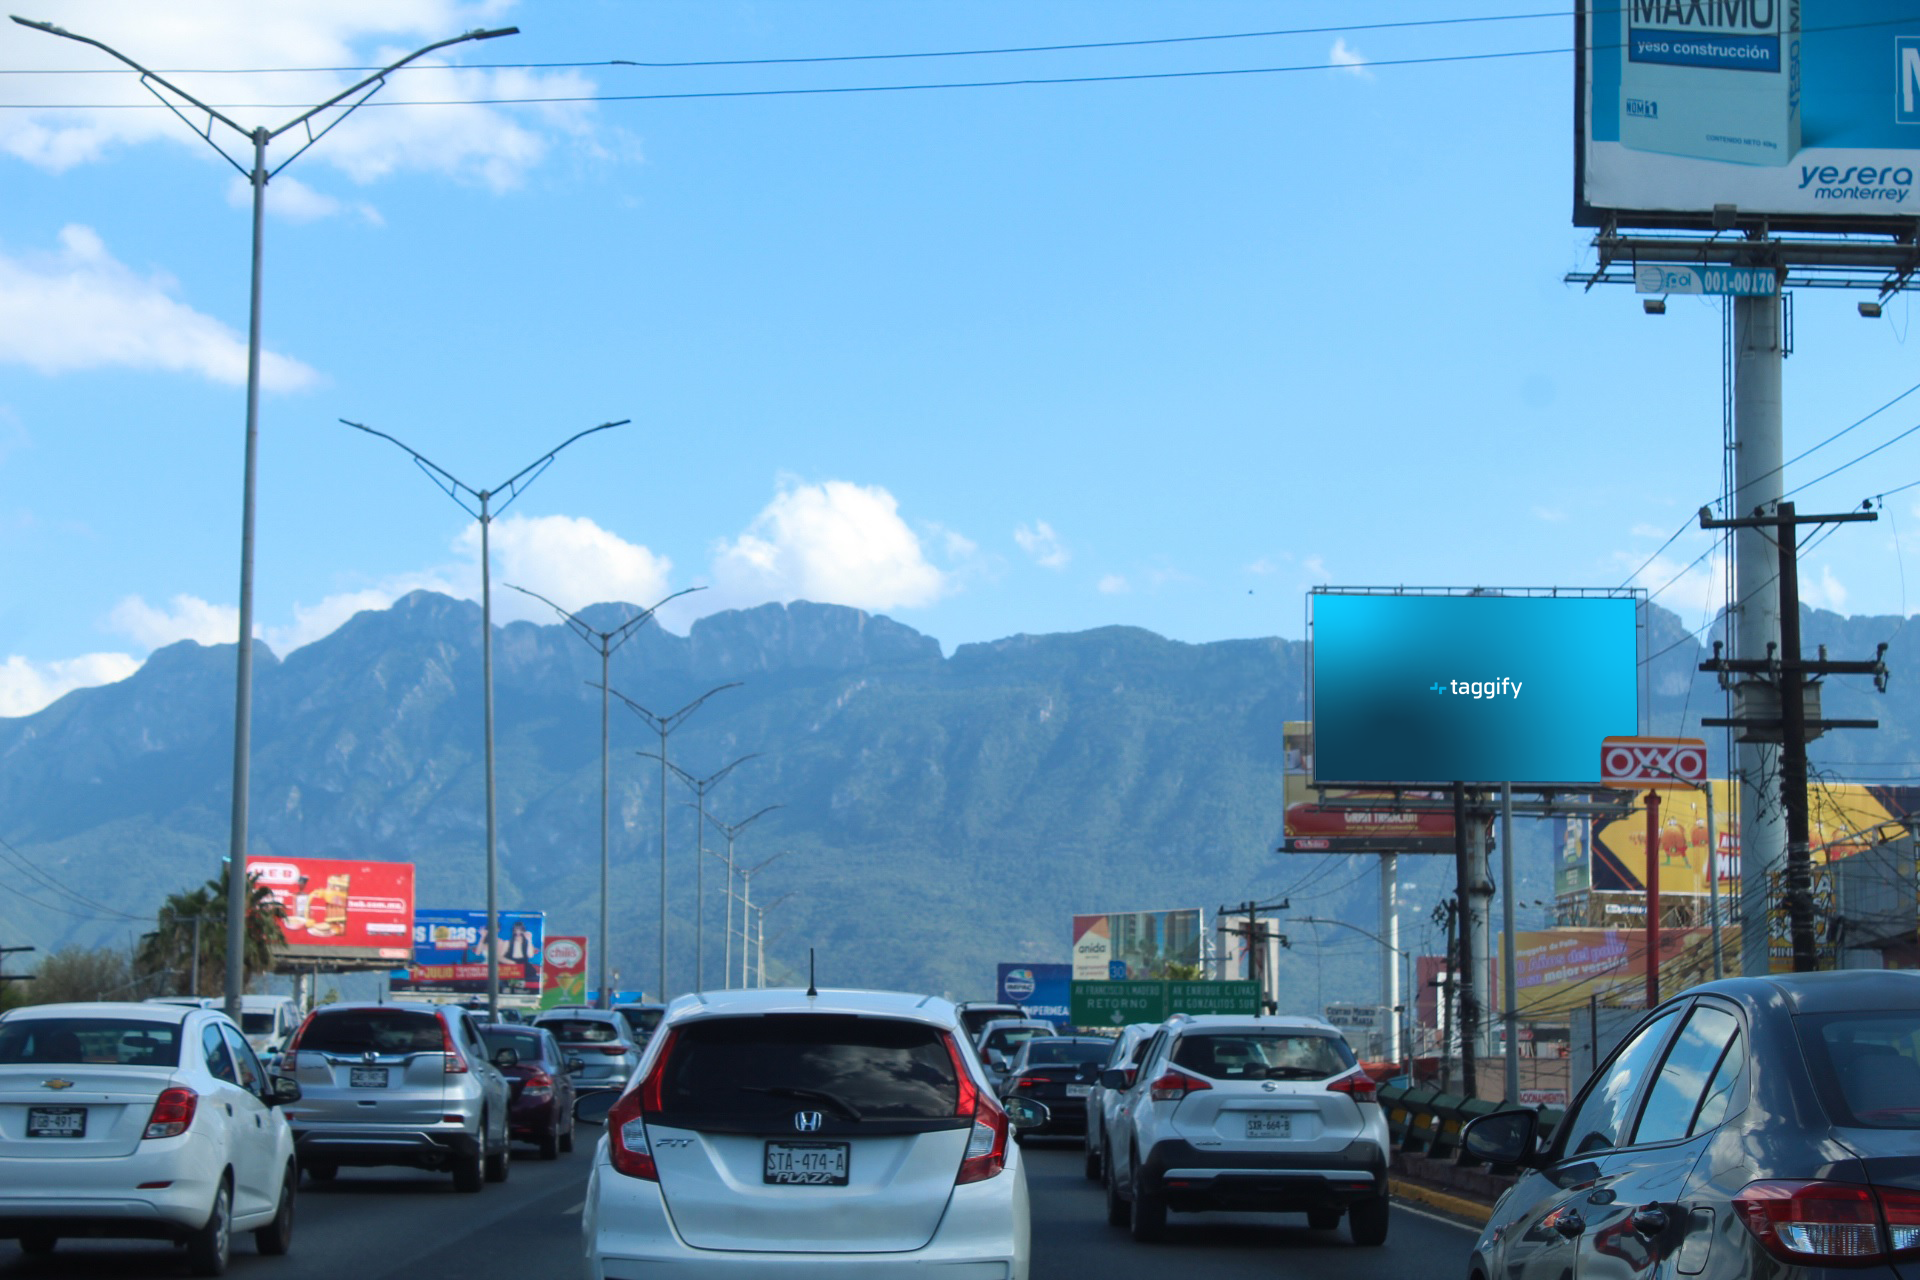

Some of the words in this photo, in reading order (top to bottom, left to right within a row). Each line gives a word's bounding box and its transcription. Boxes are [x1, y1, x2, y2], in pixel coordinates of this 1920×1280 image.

[1637, 41, 1669, 54] yeso
[1673, 43, 1770, 60] construcción
[1798, 165, 1913, 189] yesera
[1814, 186, 1909, 203] monterrey
[1704, 271, 1775, 293] 001-00170
[1450, 677, 1523, 699] taggify
[1605, 747, 1703, 779] OXXO
[1078, 943, 1106, 953] anida
[1544, 966, 1580, 982] mejor
[1582, 956, 1629, 973] versión
[1132, 986, 1160, 995] MADERO
[1186, 986, 1220, 996] ENRIQUE
[1234, 986, 1256, 996] LIVAS
[1087, 999, 1148, 1009] RETORNO
[1186, 999, 1235, 1009] GONZALITOS
[1239, 999, 1256, 1009] SUR
[656, 1139, 695, 1148] FIT
[768, 1152, 844, 1171] STA-474-A
[775, 1171, 833, 1184] PLAZA
